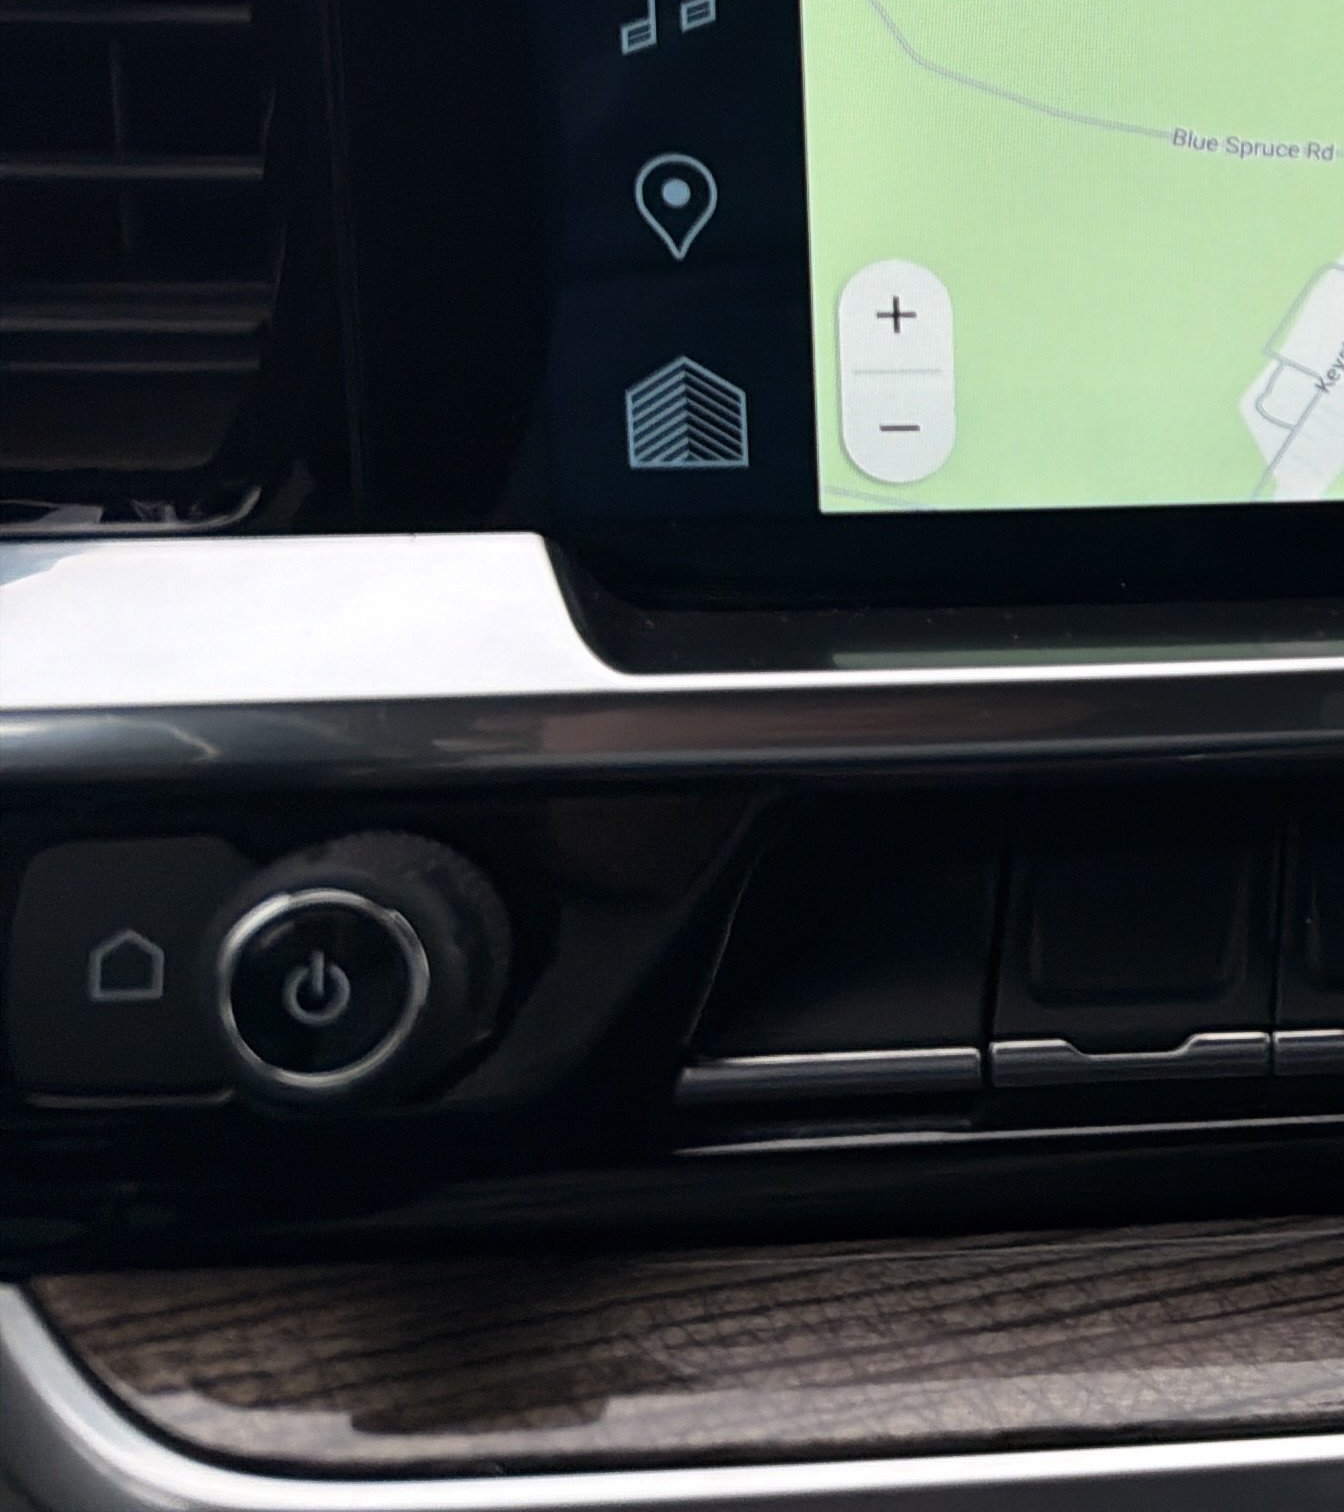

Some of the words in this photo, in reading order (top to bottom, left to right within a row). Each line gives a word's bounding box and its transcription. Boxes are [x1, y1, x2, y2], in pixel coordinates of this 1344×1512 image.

[1172, 128, 1218, 153] Blue
[1225, 136, 1299, 164] Spruce
[1306, 142, 1334, 161] Rd
